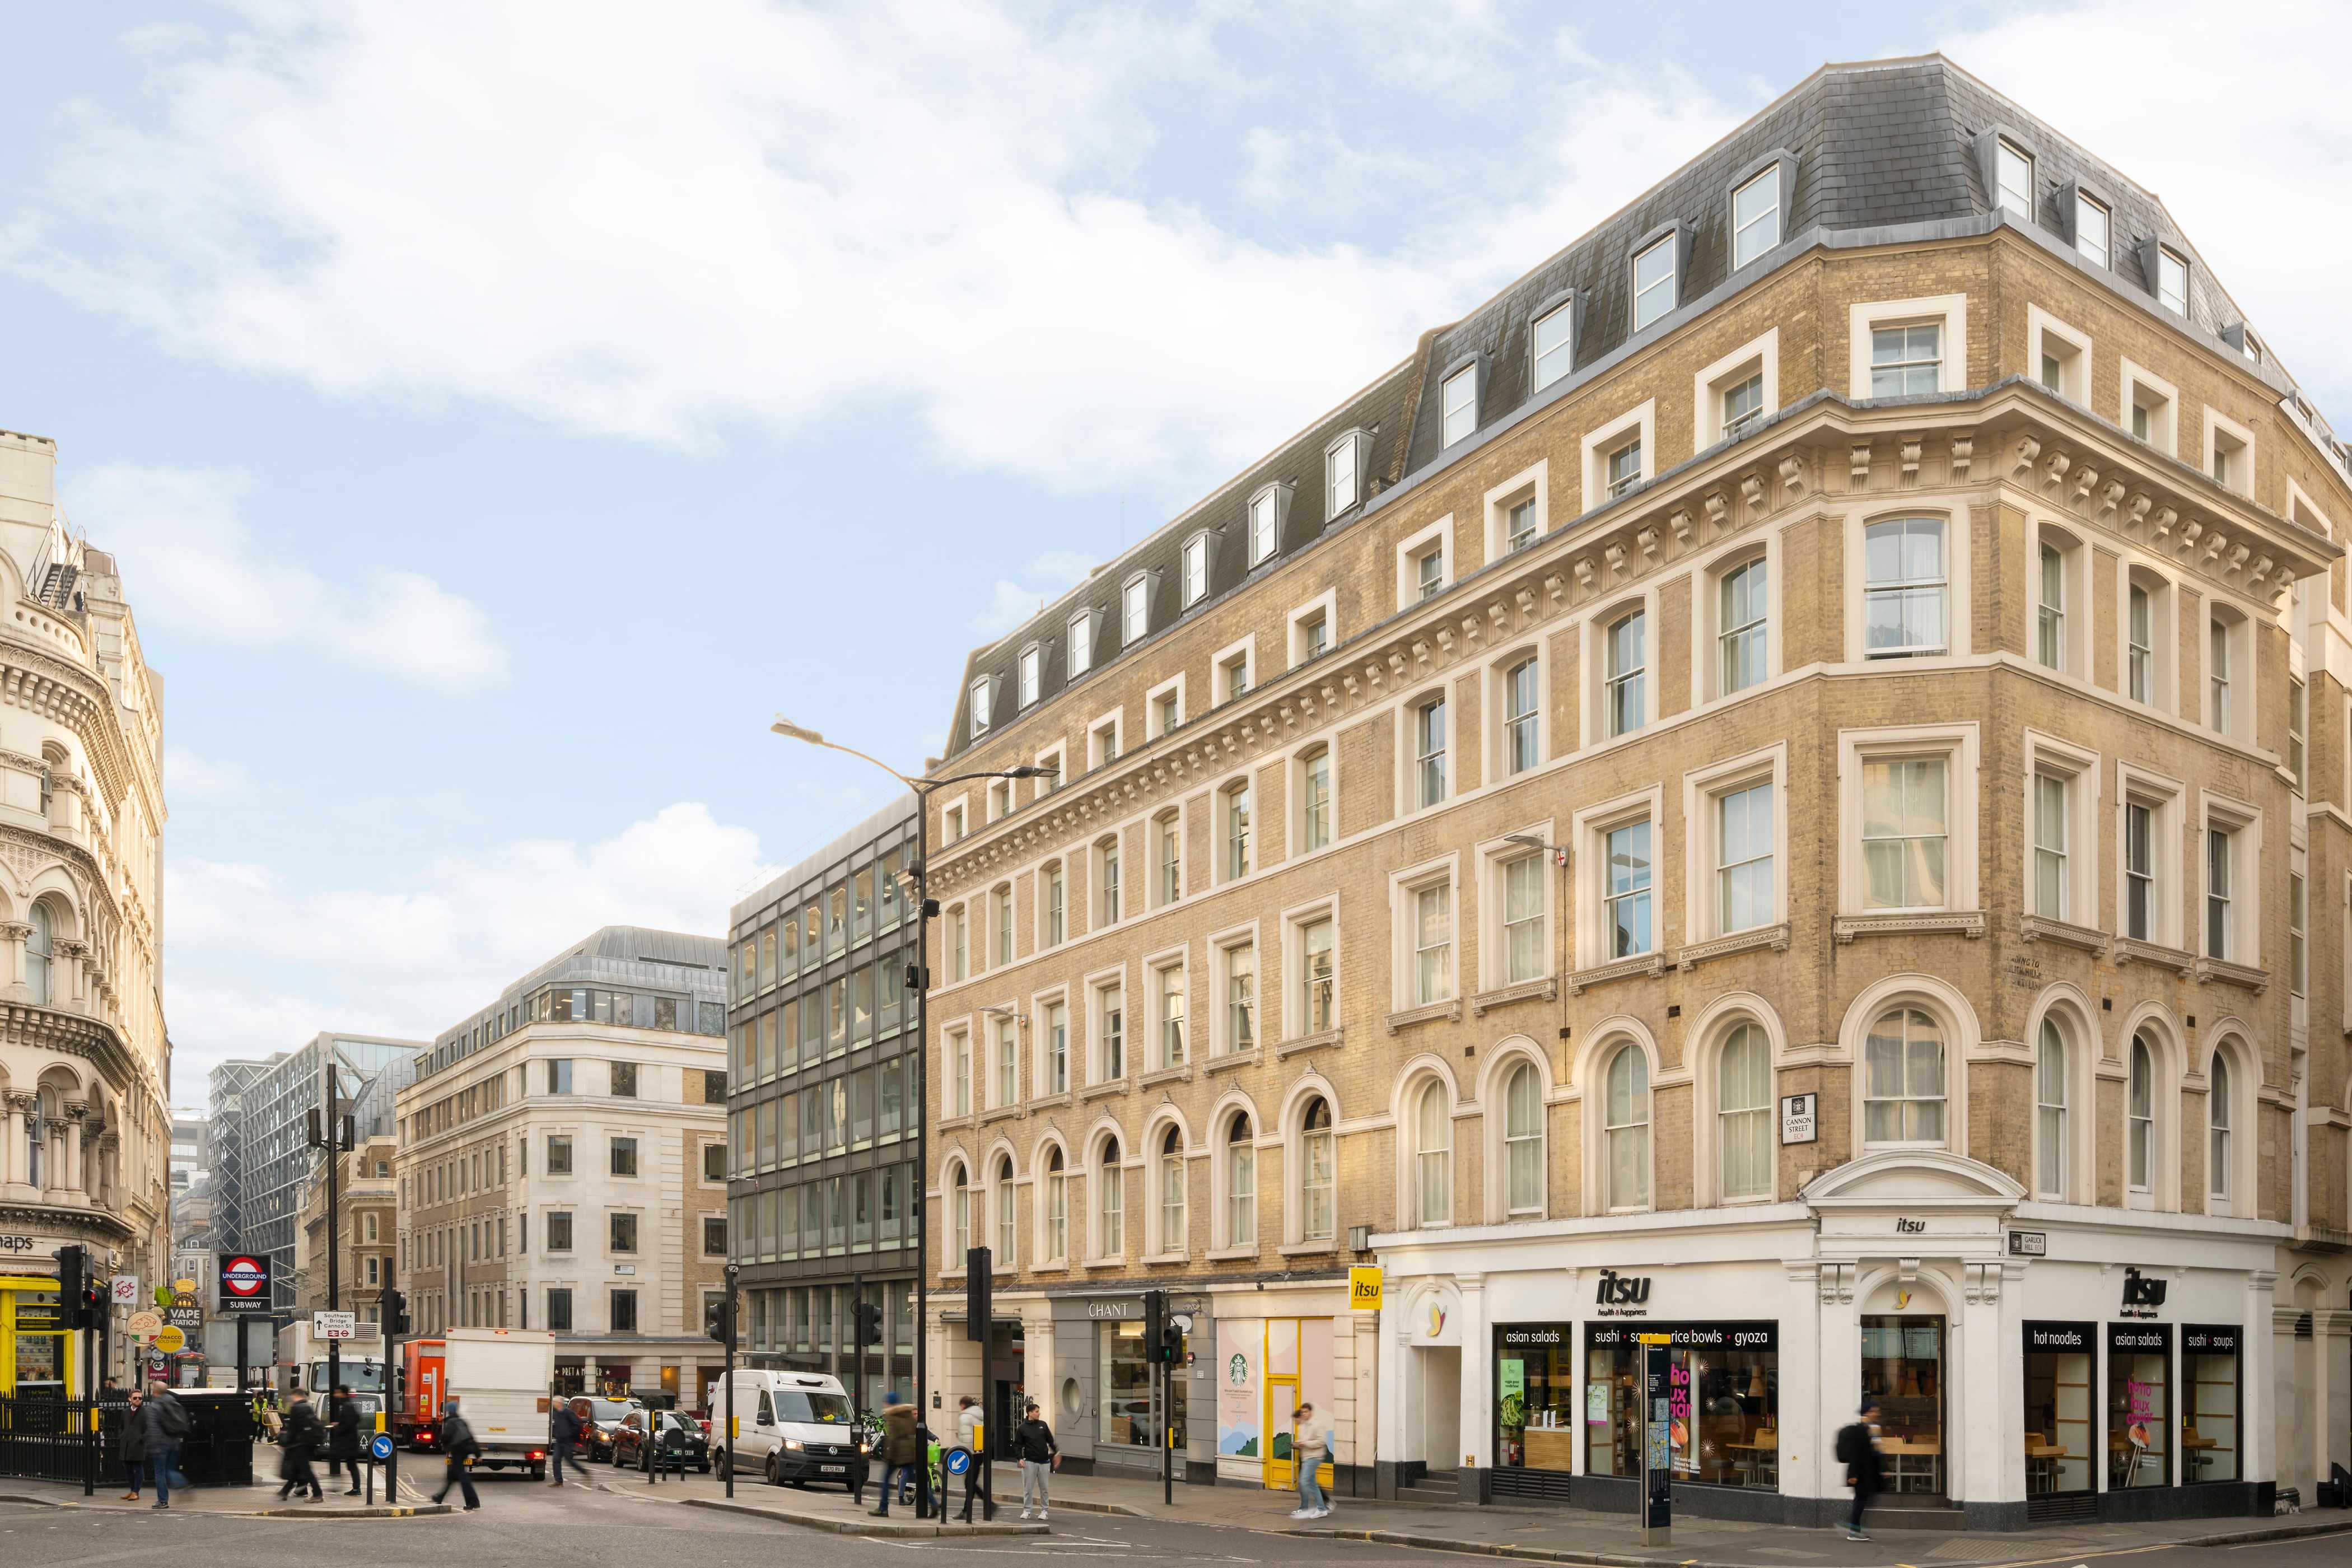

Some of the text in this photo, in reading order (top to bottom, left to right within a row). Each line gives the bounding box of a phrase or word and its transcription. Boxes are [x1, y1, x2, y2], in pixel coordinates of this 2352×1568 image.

[1786, 1117, 1811, 1126] CANNON
[1896, 1217, 1925, 1232] itsu
[0, 1236, 33, 1253] aps
[1355, 1281, 1379, 1296] itsu
[1596, 1269, 1650, 1304] itsu
[2122, 1267, 2167, 1305] itsu
[170, 1309, 200, 1319] VAPE
[1089, 1303, 1128, 1317] CHANT
[1620, 1308, 1647, 1317] happiness
[1506, 1330, 1560, 1342] asian salads
[1595, 1329, 1619, 1342] sushi
[1734, 1332, 1767, 1346] gyoza
[2034, 1331, 2081, 1345] hot noodles
[2116, 1333, 2162, 1346] asian salads
[2188, 1334, 2233, 1349] sushi soups
[562, 1367, 575, 1376] PRET
[581, 1368, 603, 1376] MER
[1670, 1362, 1690, 1385] ho
[1670, 1388, 1687, 1403] ux
[2141, 1380, 2151, 1397] ho
[2130, 1394, 2149, 1412] faux
